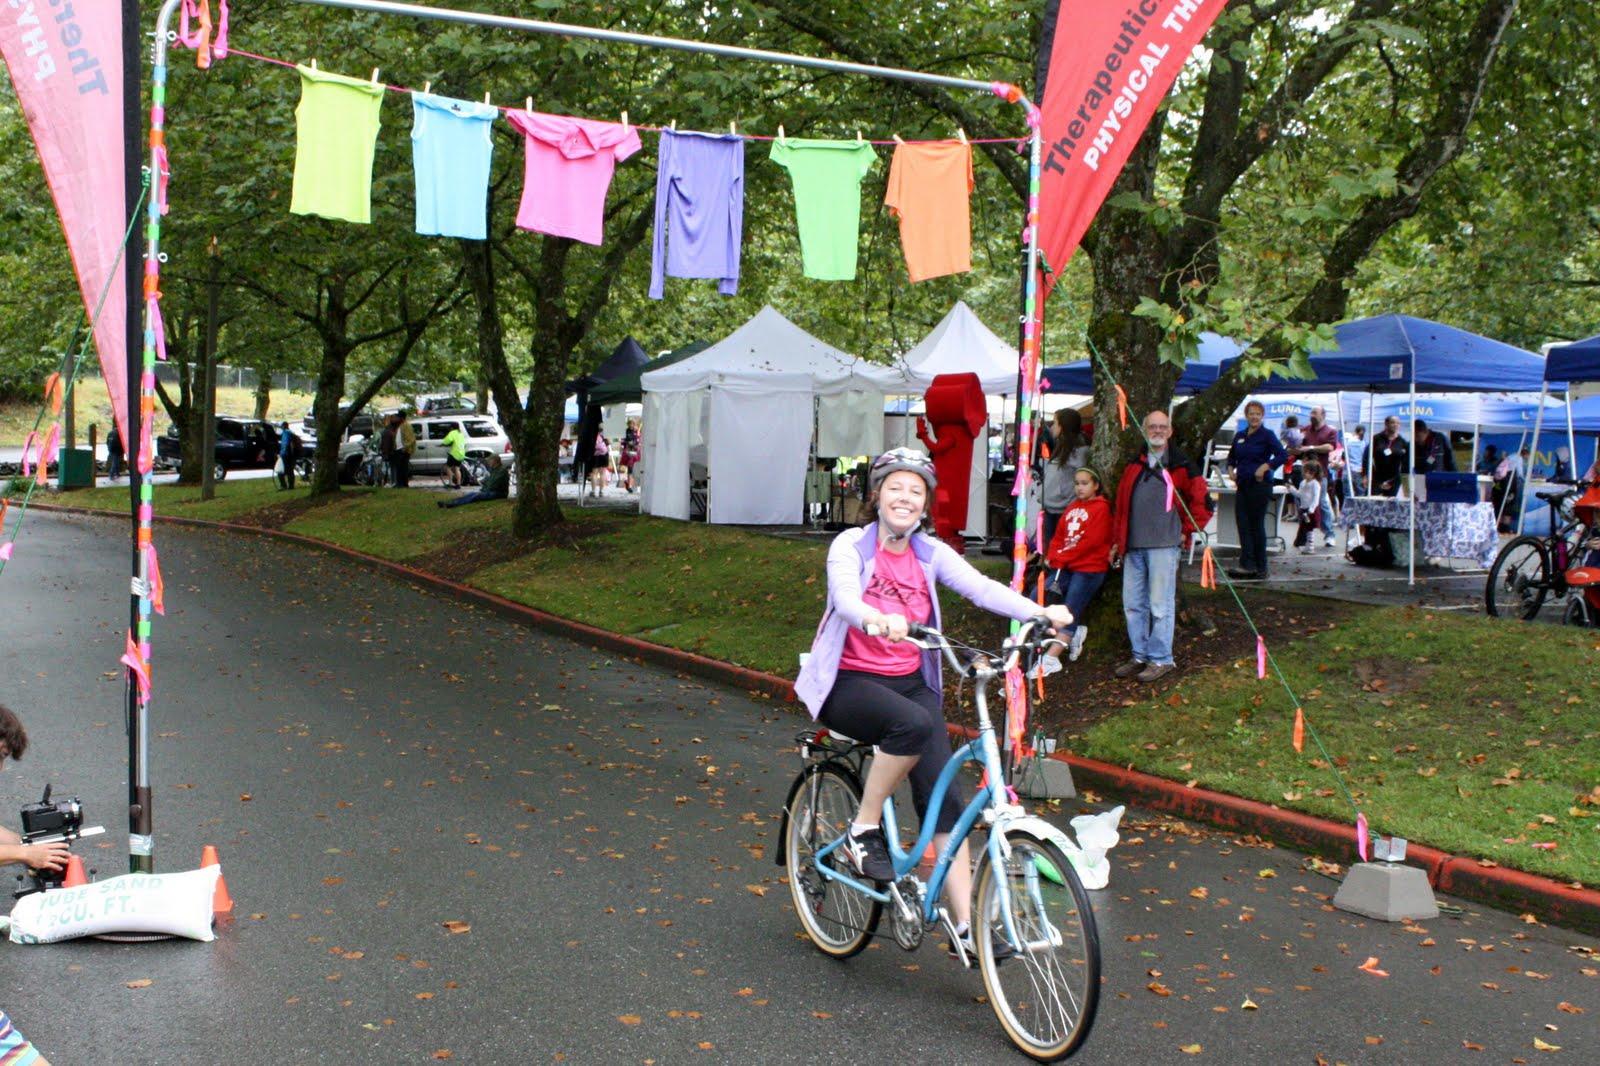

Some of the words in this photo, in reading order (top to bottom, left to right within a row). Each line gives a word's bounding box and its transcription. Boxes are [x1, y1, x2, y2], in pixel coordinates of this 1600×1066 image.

[1043, 0, 1159, 176] Therapeutic
[1083, 42, 1170, 171] PHYSICAL
[1162, 0, 1204, 33] TH
[1271, 404, 1302, 414] LUNA
[1399, 406, 1434, 416] LUNA
[100, 877, 163, 894] SAND
